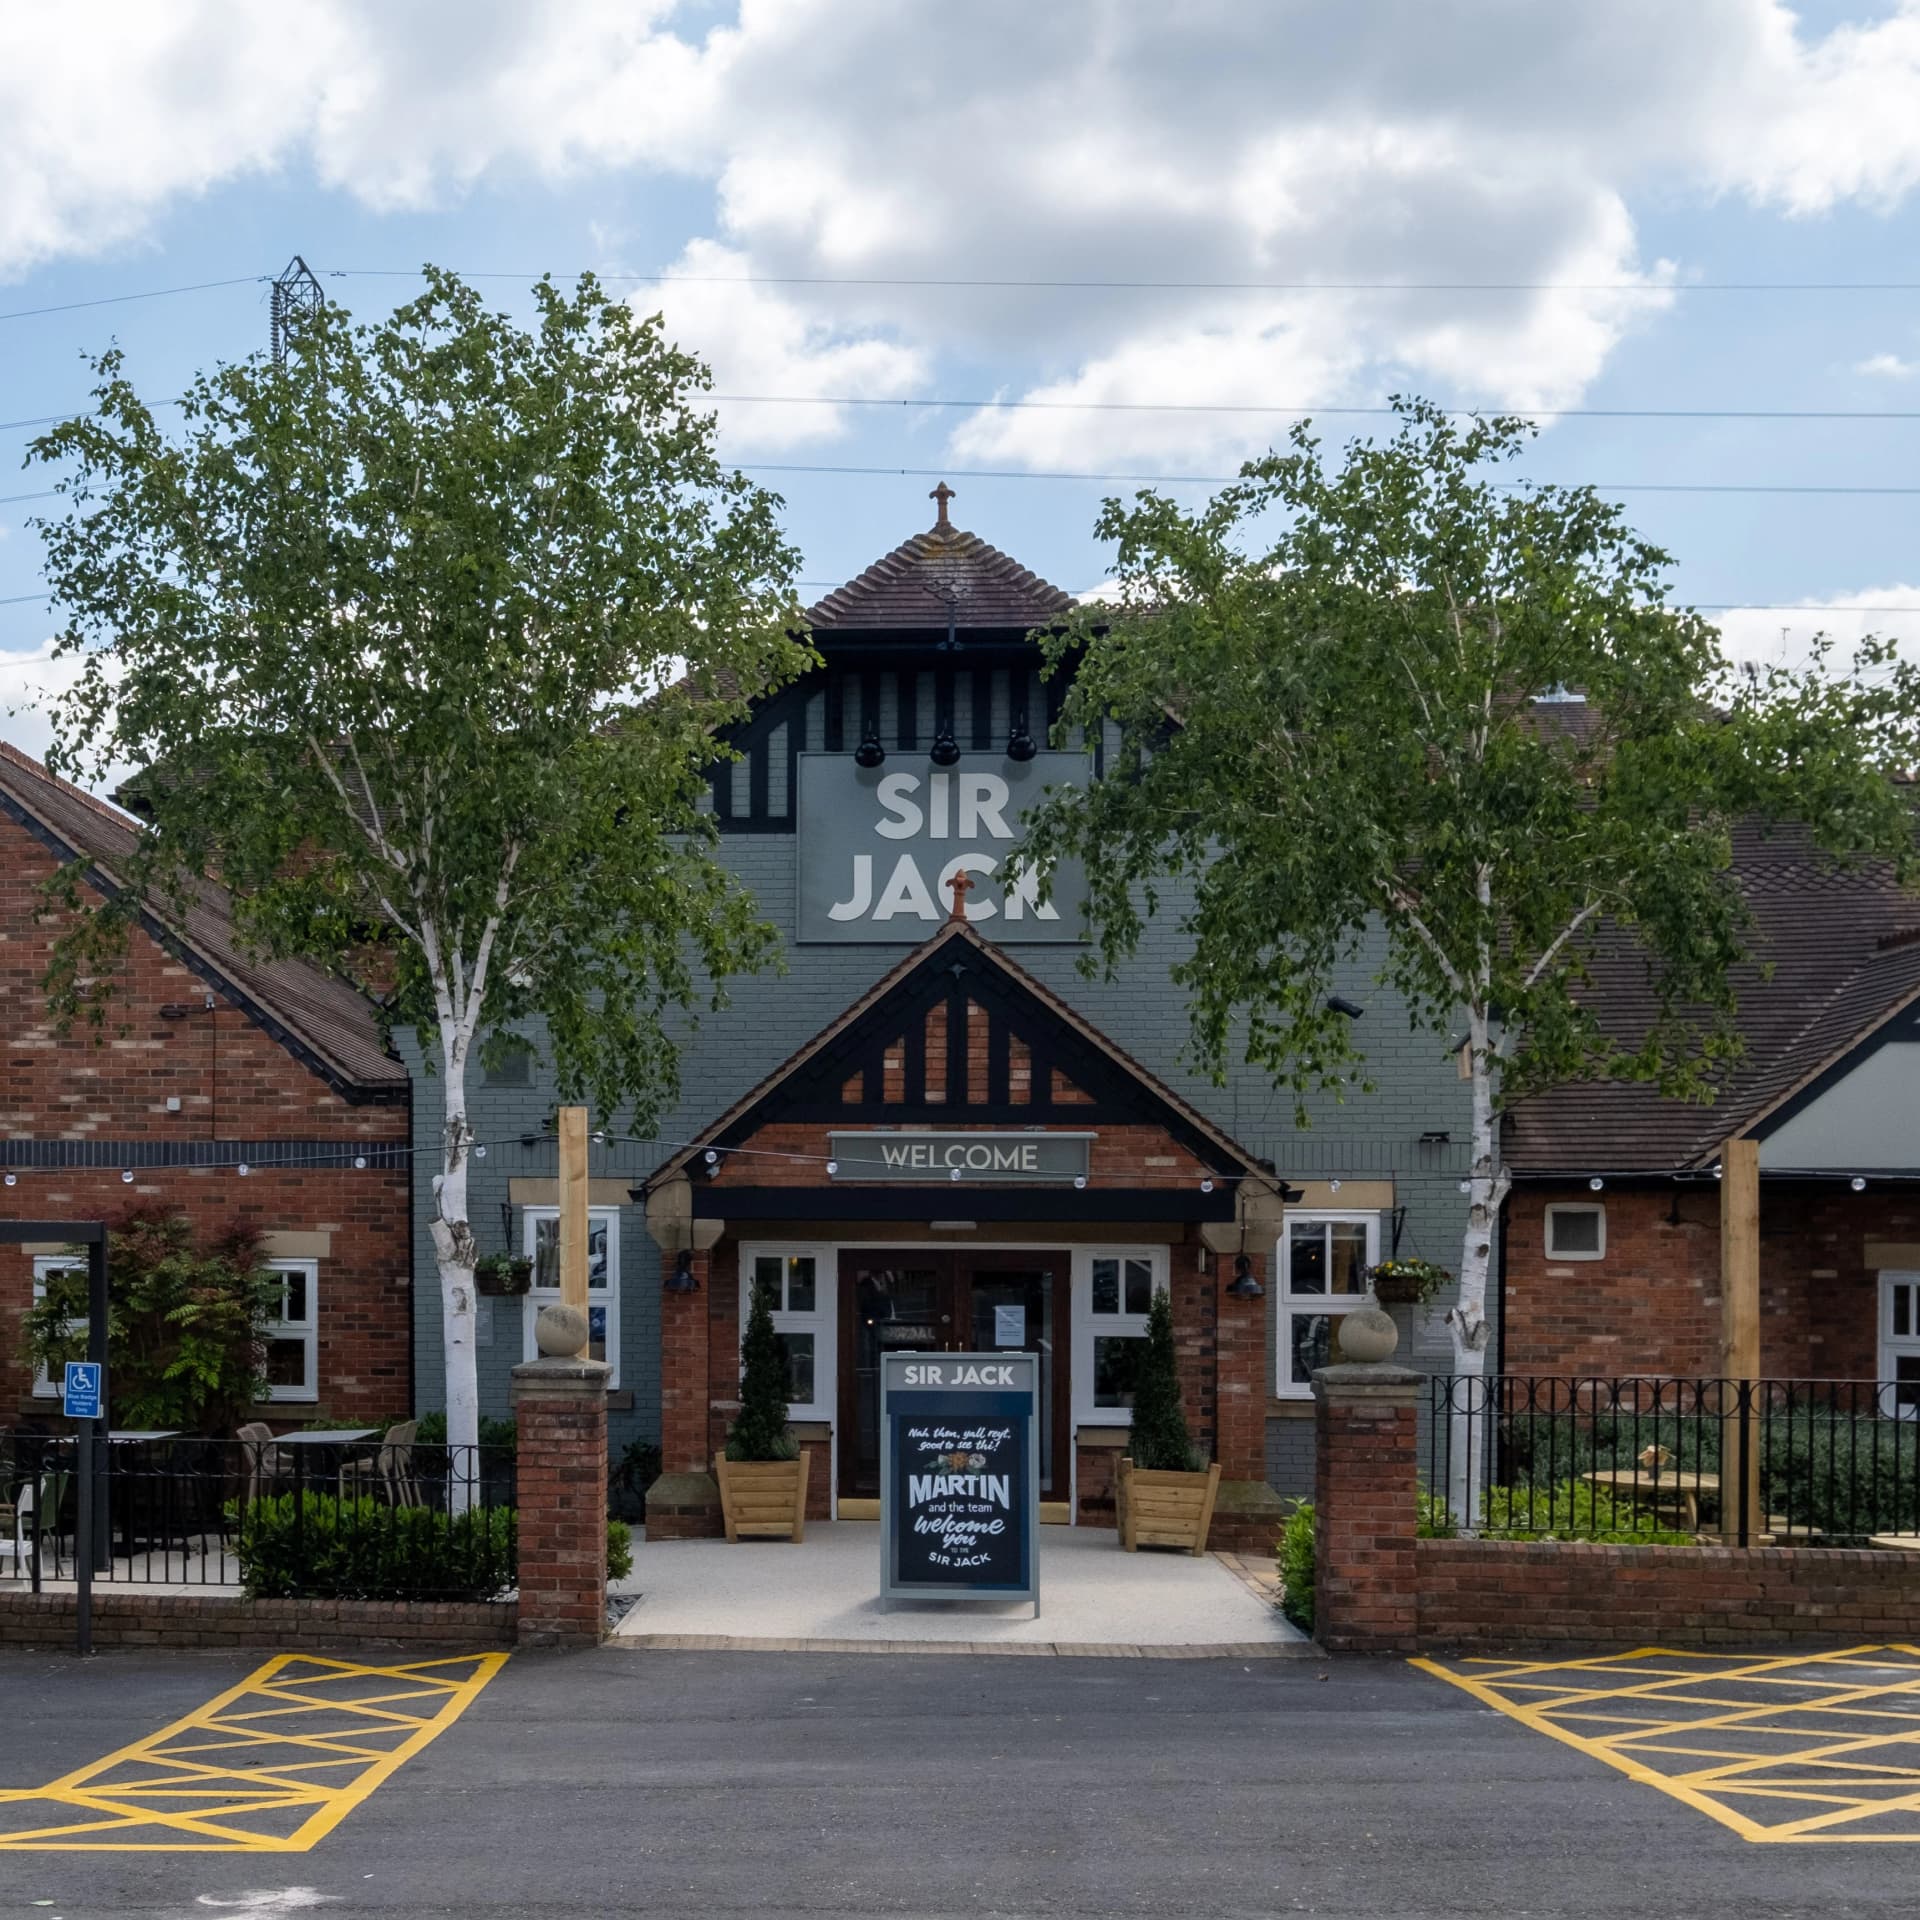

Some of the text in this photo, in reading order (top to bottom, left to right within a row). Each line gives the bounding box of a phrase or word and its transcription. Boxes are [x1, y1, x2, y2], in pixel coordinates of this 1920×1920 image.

[874, 772, 1015, 840] SIR
[827, 853, 1061, 922] JACK
[881, 1144, 1038, 1170] WELCOME
[904, 1365, 1015, 1385] SIR JACK
[918, 1440, 945, 1451] good
[945, 1441, 955, 1449] to
[957, 1441, 973, 1449] see
[909, 1474, 1010, 1510] MARTIN
[928, 1501, 992, 1512] and the team
[914, 1513, 1005, 1535] welcome
[942, 1533, 977, 1549] you
[928, 1552, 991, 1567] SIR JACK
